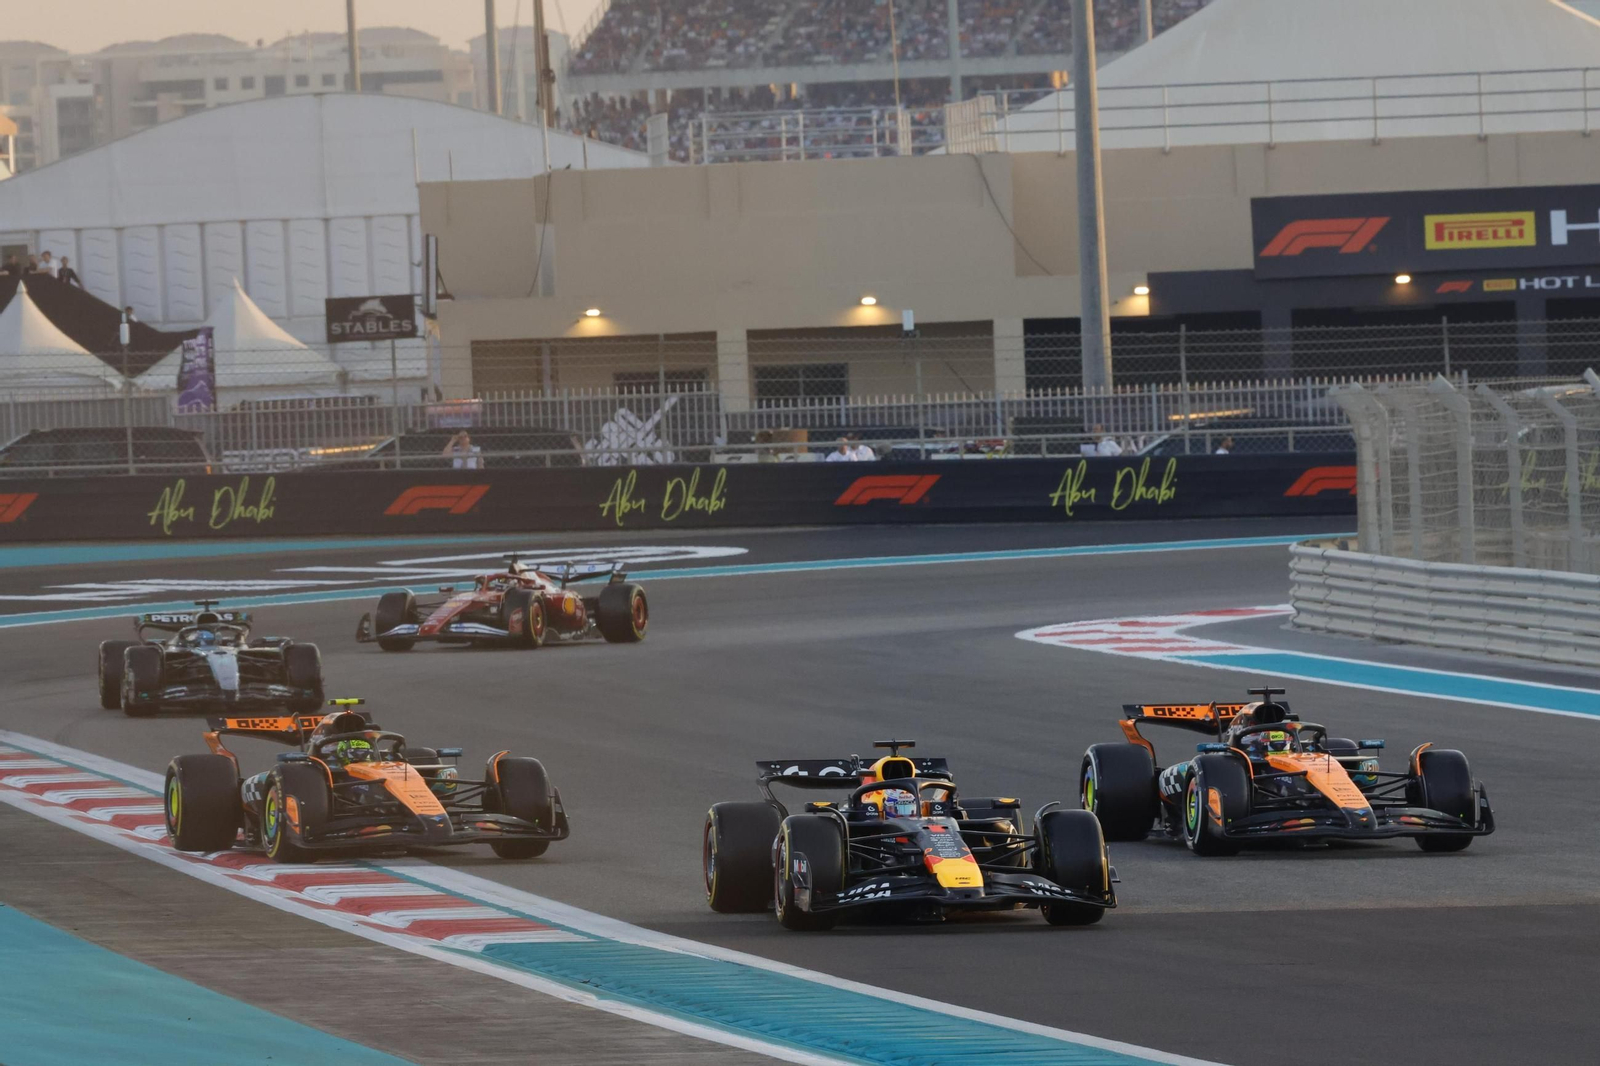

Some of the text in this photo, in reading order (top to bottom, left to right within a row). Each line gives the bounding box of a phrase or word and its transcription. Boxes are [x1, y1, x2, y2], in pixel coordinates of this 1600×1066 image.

[1259, 217, 1391, 256] F1
[1434, 219, 1525, 242] PIRELLI
[1519, 276, 1579, 290] HOT
[331, 320, 412, 335] STABLES
[384, 485, 490, 515] F1
[599, 467, 727, 526] Abu Dhabi
[834, 474, 942, 505] F1
[1049, 457, 1178, 516] Abu Dhabi
[147, 476, 277, 534] Abu Dhabi
[237, 719, 279, 729] OKX
[1153, 707, 1196, 717] OKX
